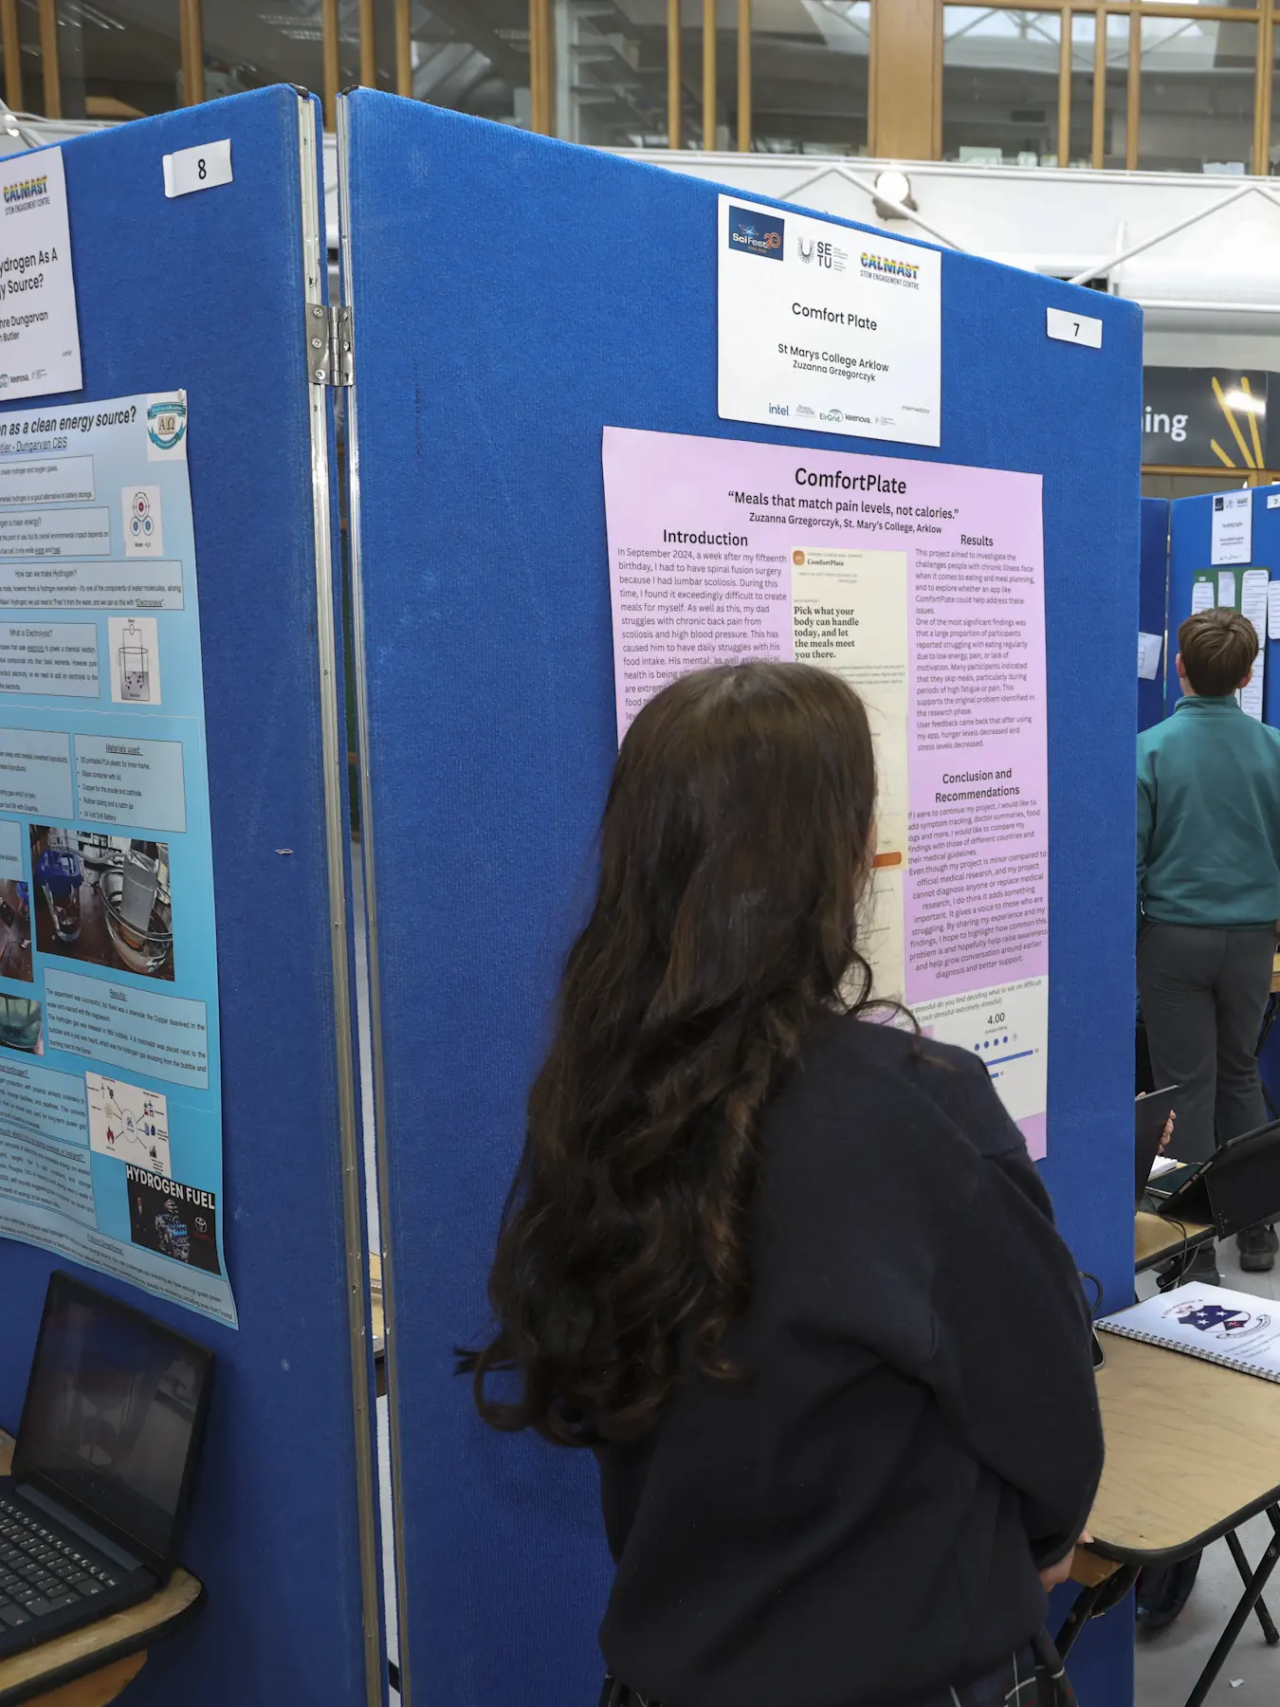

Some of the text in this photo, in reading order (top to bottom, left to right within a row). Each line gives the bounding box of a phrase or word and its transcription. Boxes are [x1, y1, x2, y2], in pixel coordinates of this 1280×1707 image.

[198, 158, 206, 180] 8
[3, 175, 48, 203] CALMAST
[39, 250, 49, 264] As
[52, 247, 57, 262] A
[817, 241, 832, 255] SE
[817, 254, 832, 268] TU
[860, 252, 919, 279] CALMAST
[8, 274, 44, 294] Source?
[860, 270, 919, 290] STEM ENGAGEMENT CENTRE
[12, 311, 48, 327] Dungarvan
[792, 302, 877, 331] Comfort Plate
[4, 333, 19, 342] Butler
[1073, 322, 1080, 337] 7
[778, 343, 889, 373] St Marys College Arklow
[792, 359, 876, 383] Zuzanna Grzegorczyk
[769, 403, 789, 416] intel
[9, 406, 137, 437] as a clean energy source?
[17, 436, 67, 453] Dungarvan CBS
[795, 467, 907, 494] ComfortPlate
[728, 491, 958, 519] “Meals that match pain levels, not calories.”
[750, 513, 786, 524] Zuzanna
[788, 515, 842, 529] Grzegorczyk,
[844, 519, 854, 528] St.
[885, 522, 915, 533] College,
[917, 524, 942, 534] Arklow
[663, 529, 748, 546] Introduction
[960, 535, 993, 546] Results
[618, 548, 625, 557] In
[627, 548, 670, 559] September
[673, 550, 695, 559] 2024,
[703, 552, 721, 560] week
[756, 554, 786, 563] fifteenth
[619, 562, 653, 572] birthday,
[686, 564, 705, 572] have
[707, 565, 729, 574] spinal
[731, 566, 753, 574] fusion
[755, 568, 782, 576] surgery
[619, 576, 650, 584] because
[674, 577, 702, 585] lumbar
[740, 579, 763, 589] During
[620, 590, 638, 598] time,
[645, 590, 668, 598] found
[678, 591, 723, 601] exceedingly
[725, 592, 753, 600] difficult
[794, 606, 854, 617] Pick what your
[794, 617, 813, 627] body
[832, 618, 859, 626] handle
[795, 628, 848, 638] today, and let
[795, 639, 808, 648] the
[810, 639, 834, 647] meals
[795, 650, 836, 660] you there.
[942, 768, 1012, 784] Conclusion and
[935, 786, 1020, 803] Recommendations
[912, 889, 935, 900] cannot
[936, 885, 964, 896] diagnose
[966, 883, 988, 892] anyone
[997, 878, 1018, 887] replace
[1020, 873, 1043, 882] medical
[988, 1012, 1005, 1024] 4.00
[126, 1164, 215, 1210] HYDROGEN FUEL
